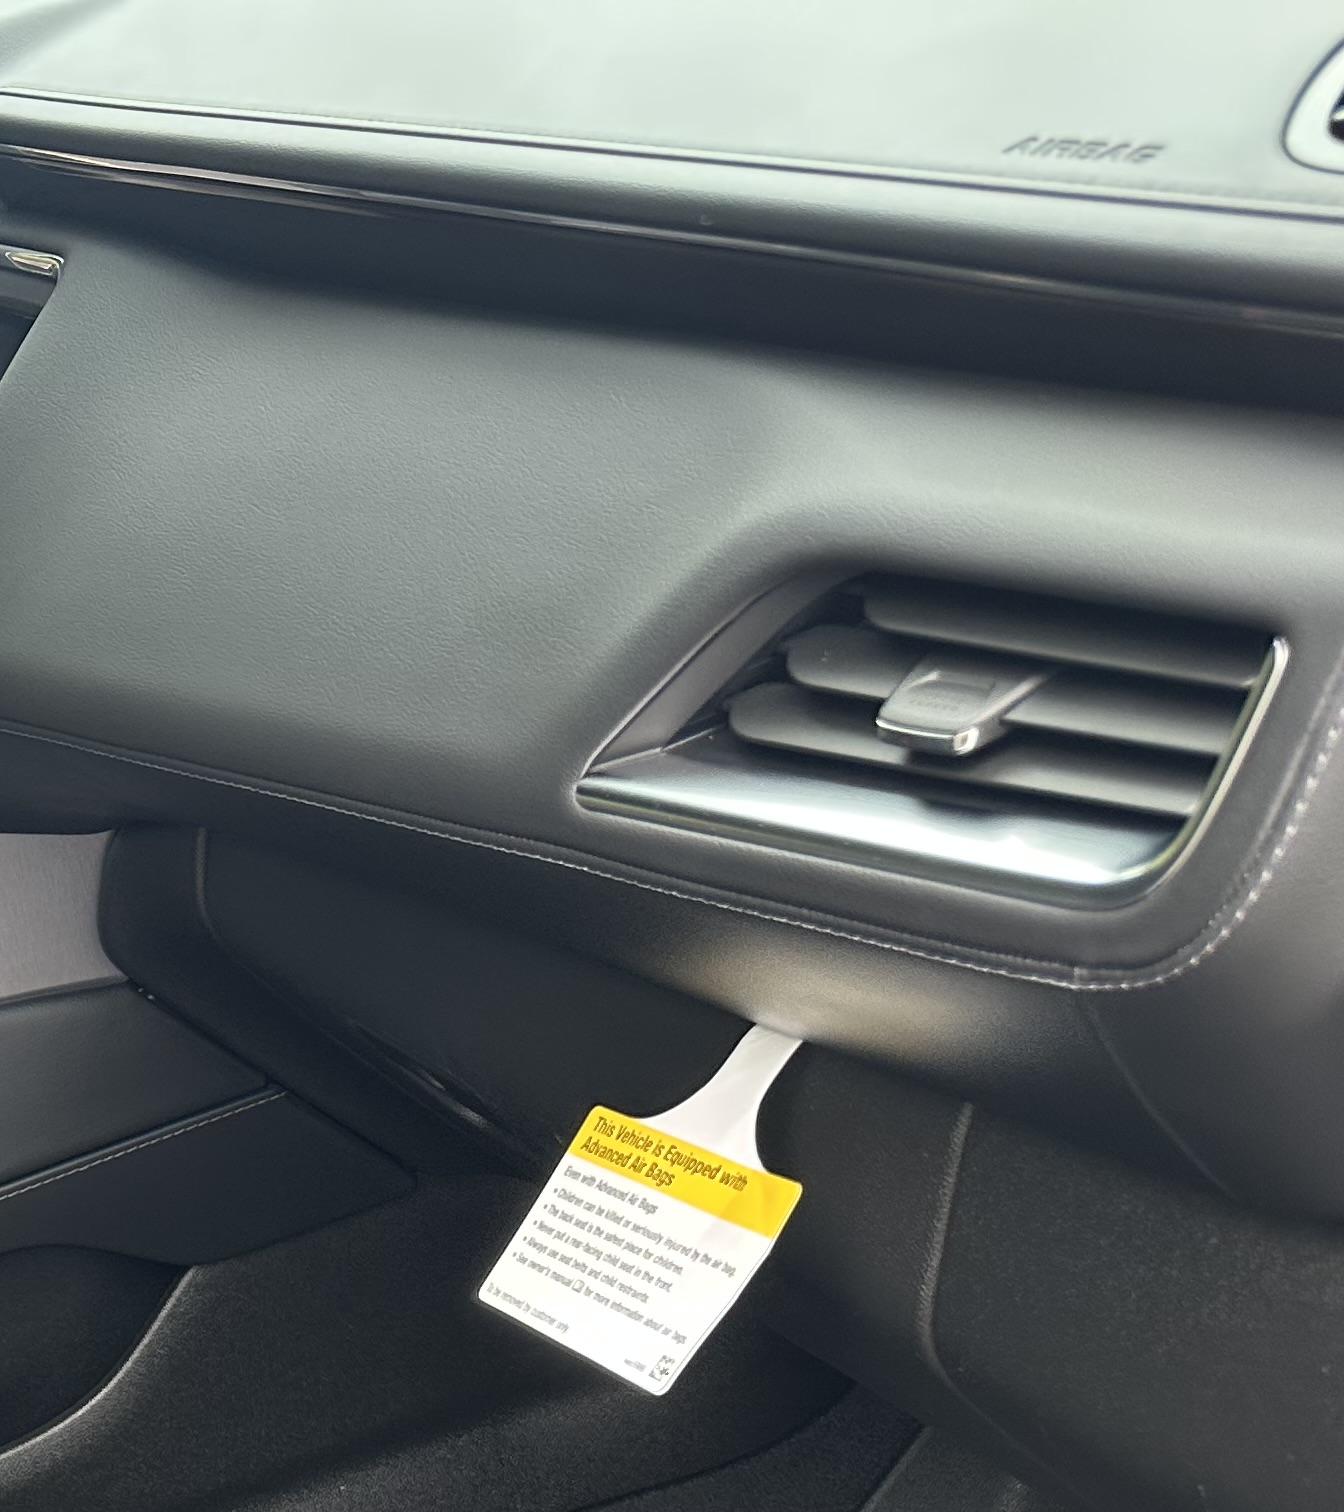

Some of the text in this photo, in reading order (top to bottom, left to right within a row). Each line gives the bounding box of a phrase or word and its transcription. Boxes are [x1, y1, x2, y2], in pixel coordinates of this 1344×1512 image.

[1002, 132, 1166, 164] AIRBAG
[580, 1135, 675, 1187] Advanced Air Bags
[593, 1115, 747, 1191] This Vehicle is Equipped with
